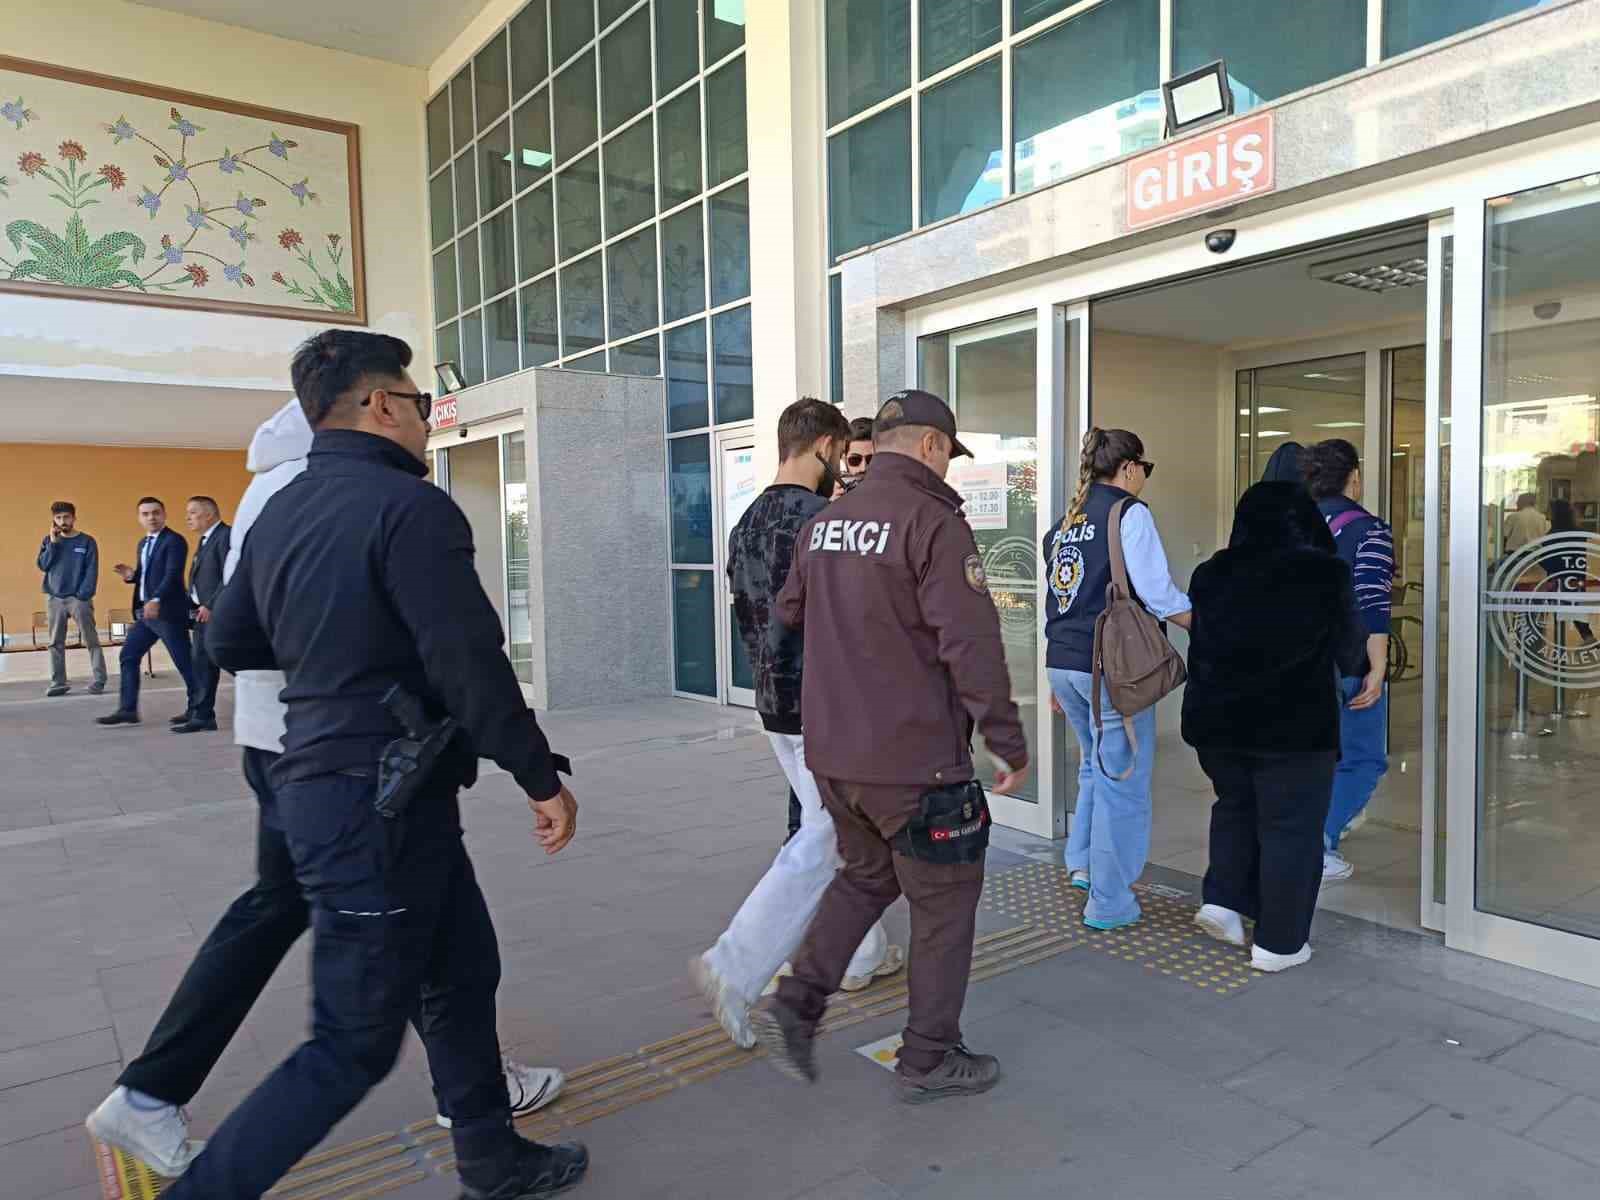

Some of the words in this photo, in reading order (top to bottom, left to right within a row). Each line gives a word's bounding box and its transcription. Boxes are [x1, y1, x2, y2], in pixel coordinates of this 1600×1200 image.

[1134, 132, 1264, 211] GİRİŞ
[435, 401, 457, 426] ÇIKIŞ
[808, 519, 891, 556] BEKÇİ
[1051, 520, 1096, 545] POLİS
